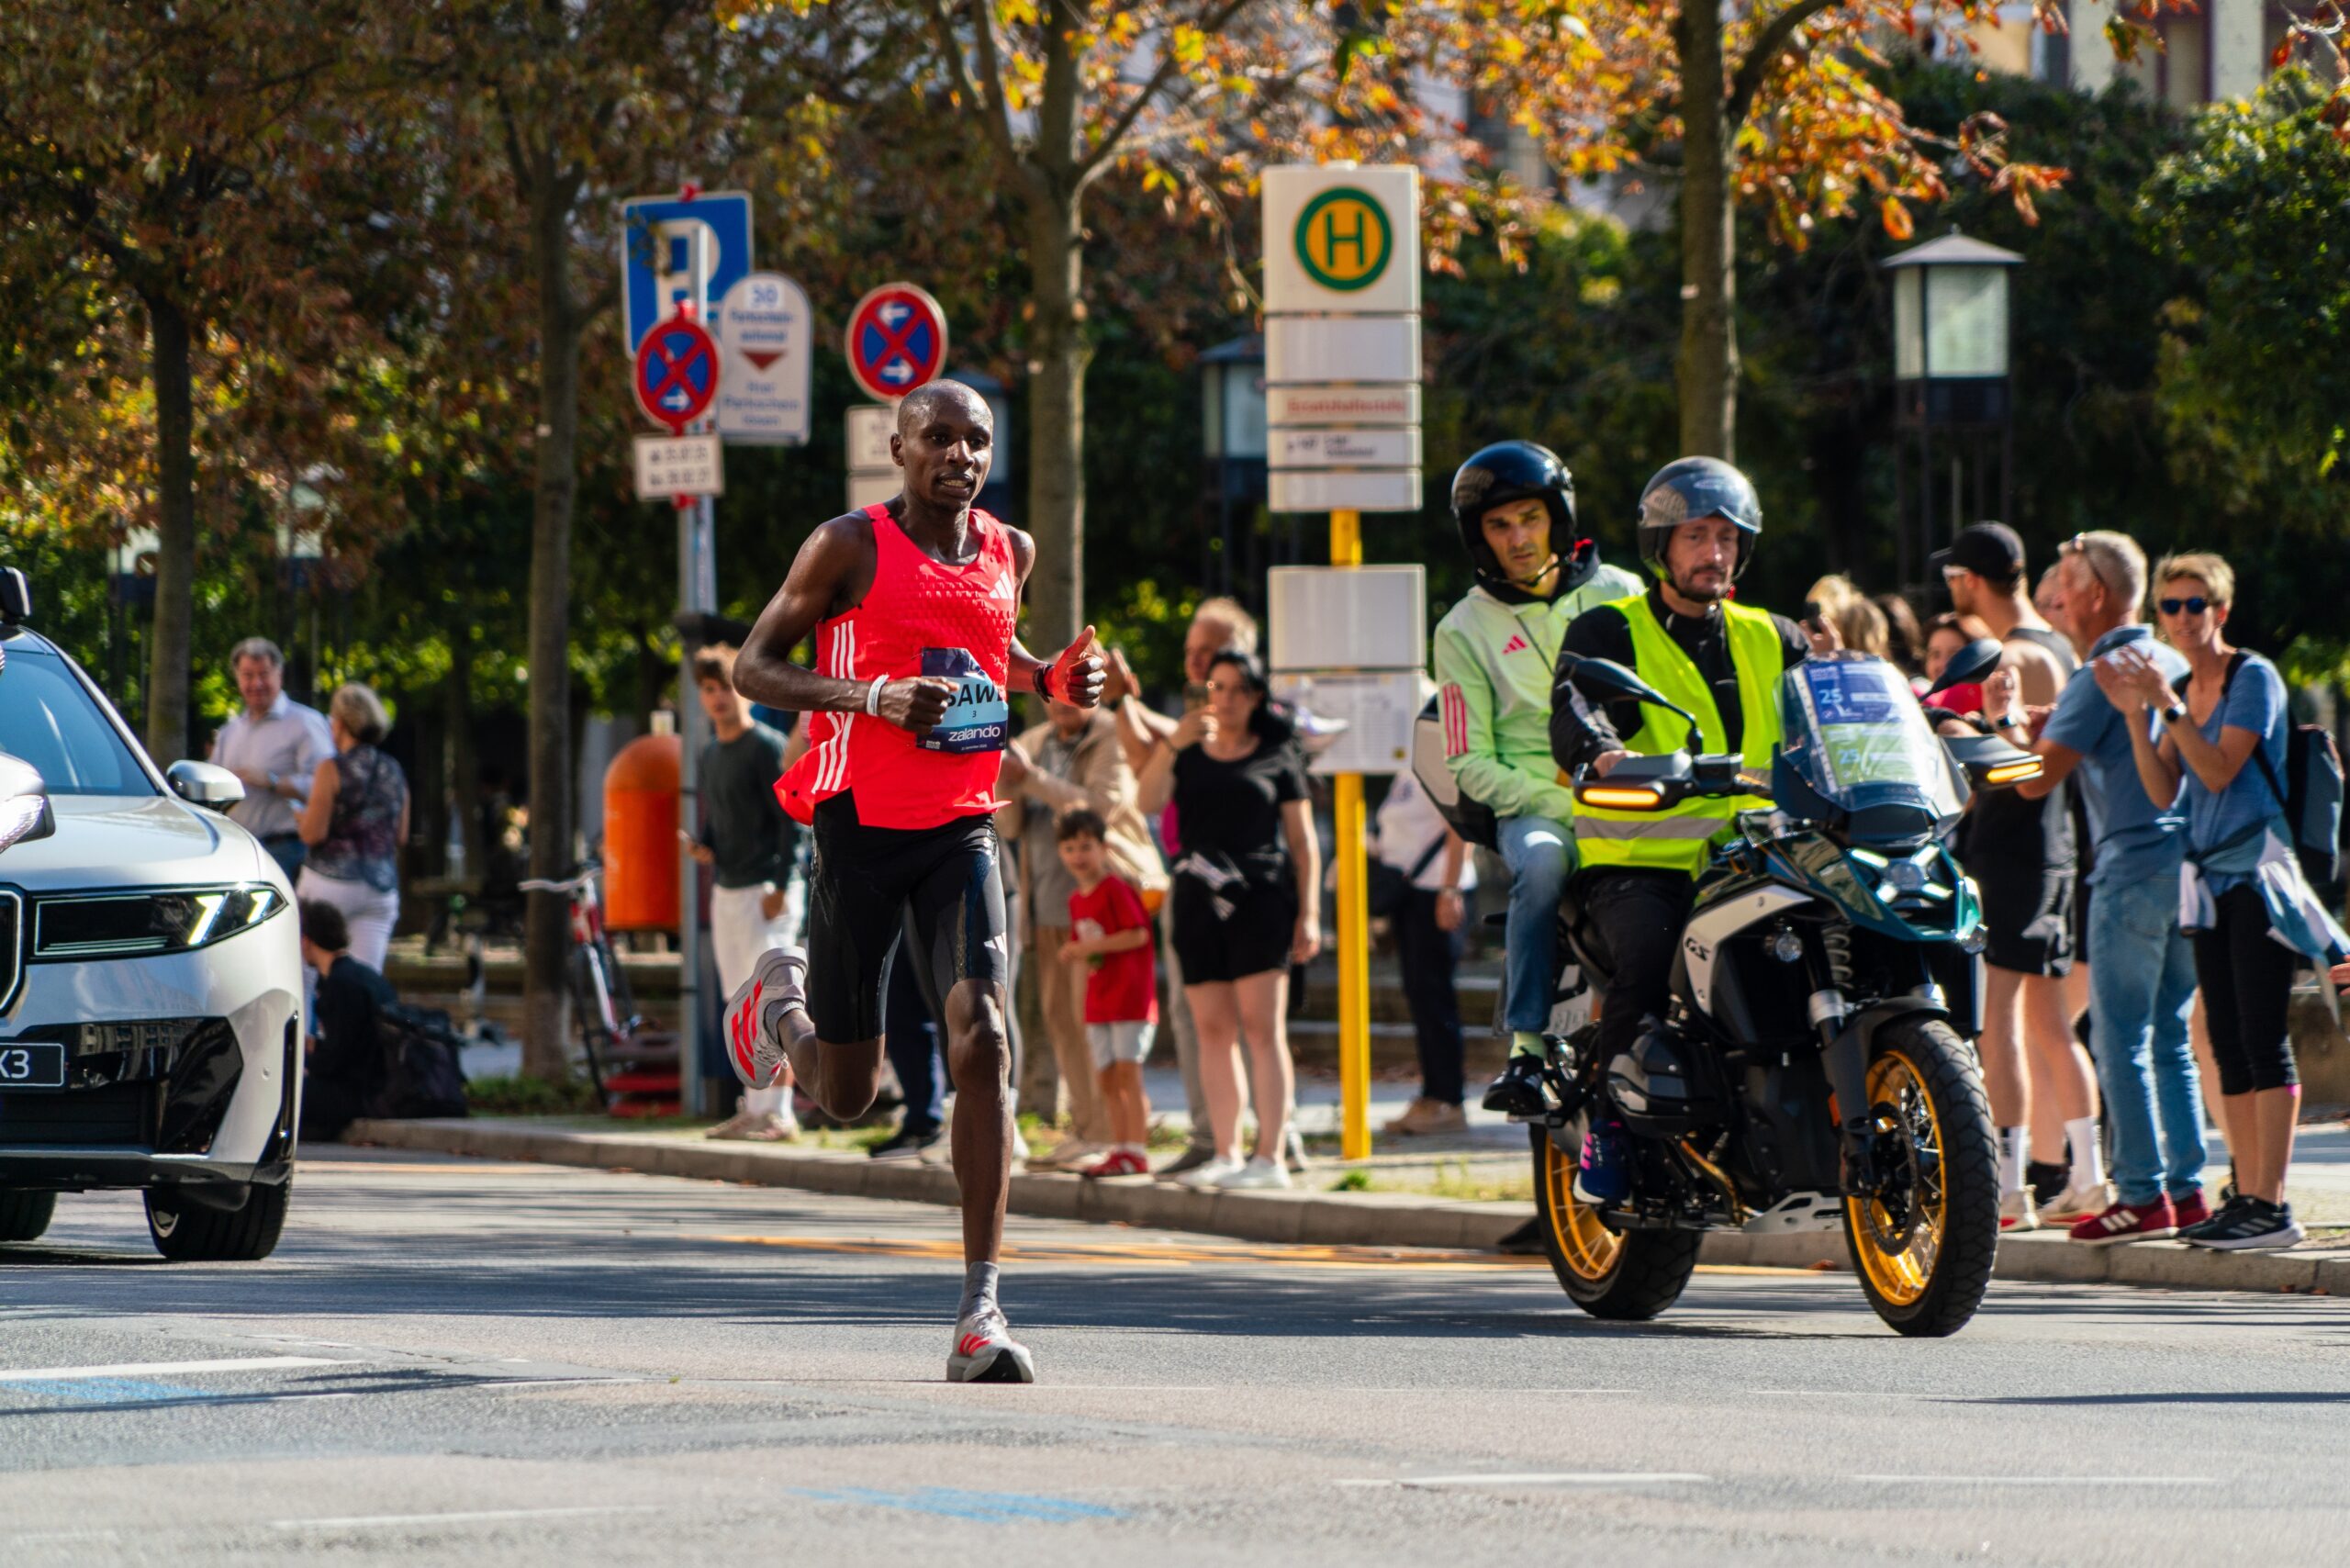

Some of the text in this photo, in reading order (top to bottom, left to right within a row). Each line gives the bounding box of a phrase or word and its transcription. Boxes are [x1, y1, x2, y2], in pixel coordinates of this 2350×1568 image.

[1325, 209, 1365, 268] H
[655, 218, 721, 323] P
[1818, 688, 1843, 705] 25
[948, 725, 1001, 742] zalando
[1685, 936, 1711, 961] GS
